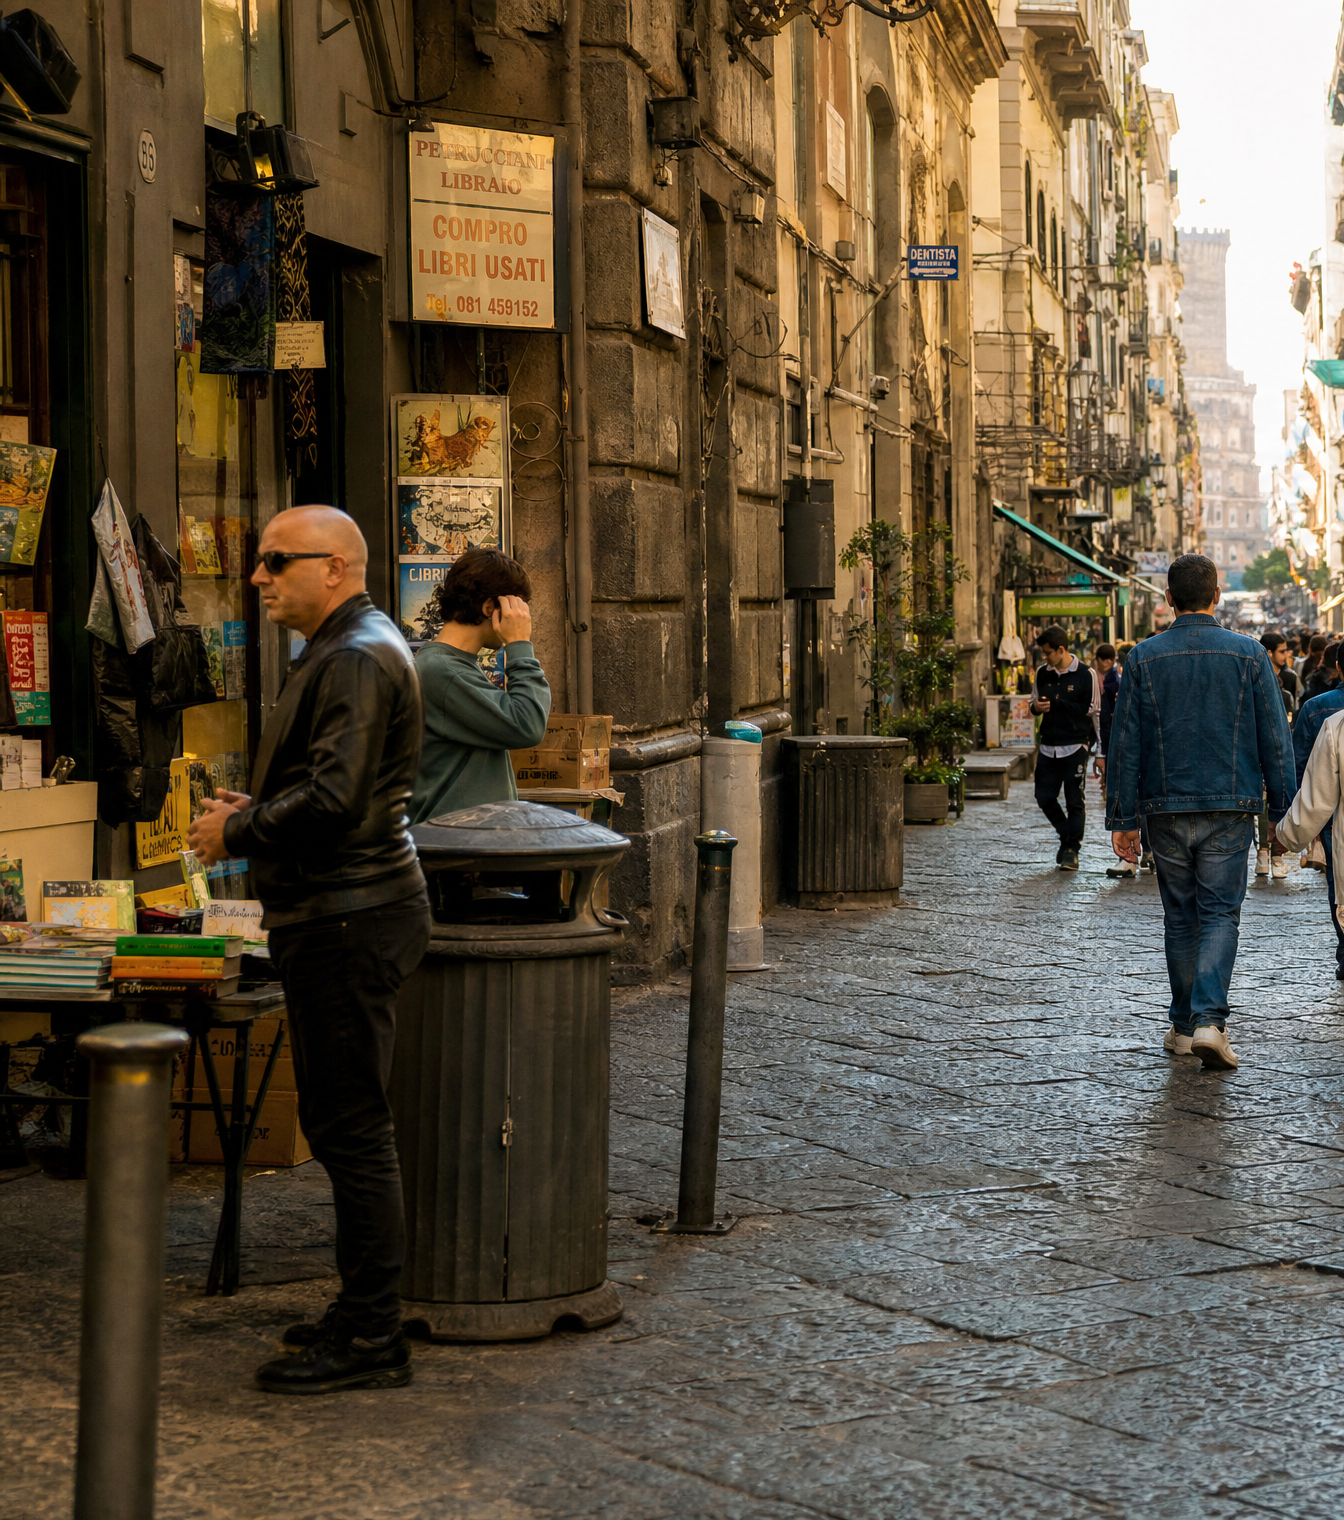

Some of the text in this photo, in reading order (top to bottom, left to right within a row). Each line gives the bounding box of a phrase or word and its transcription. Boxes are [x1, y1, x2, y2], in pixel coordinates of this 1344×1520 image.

[440, 171, 523, 195] LIBRAIO
[432, 214, 528, 247] COMPRO
[418, 249, 546, 283] LIBRI USATI
[910, 248, 957, 260] DENTISTA
[426, 293, 539, 318] Tel. 081 459152
